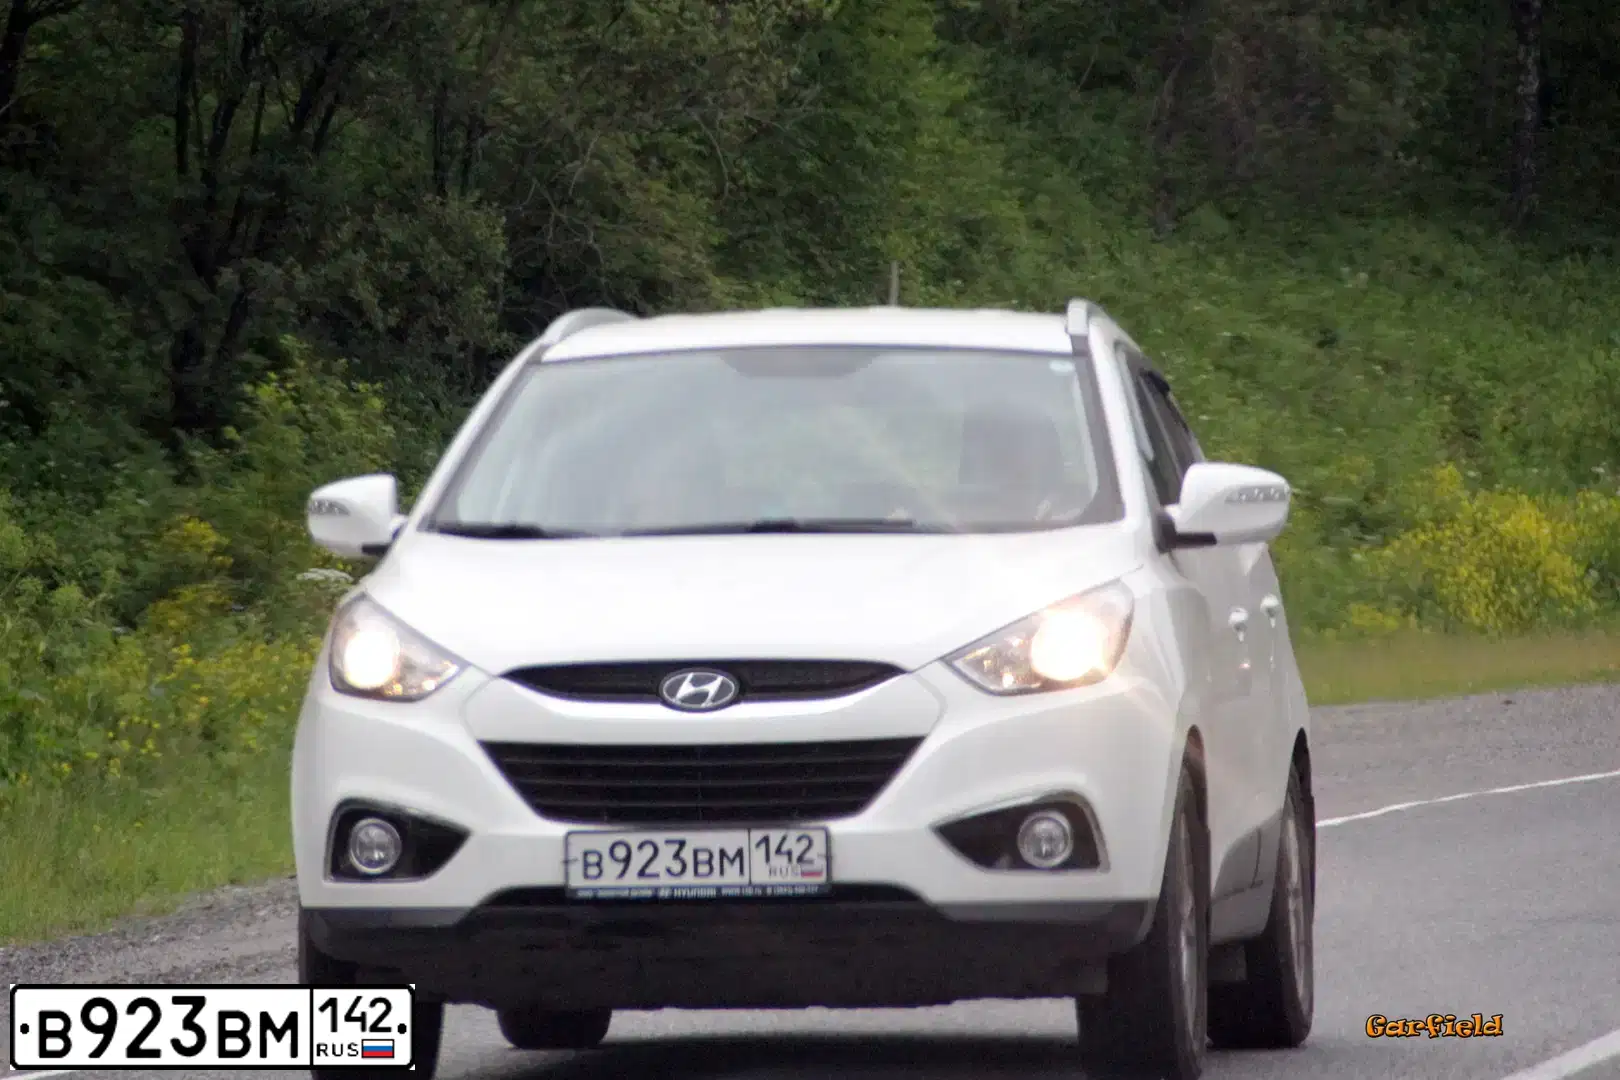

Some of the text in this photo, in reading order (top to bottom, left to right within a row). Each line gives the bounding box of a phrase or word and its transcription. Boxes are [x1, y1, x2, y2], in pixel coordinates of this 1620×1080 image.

[582, 833, 815, 880] B923BM 142
[768, 866, 801, 878] RUS
